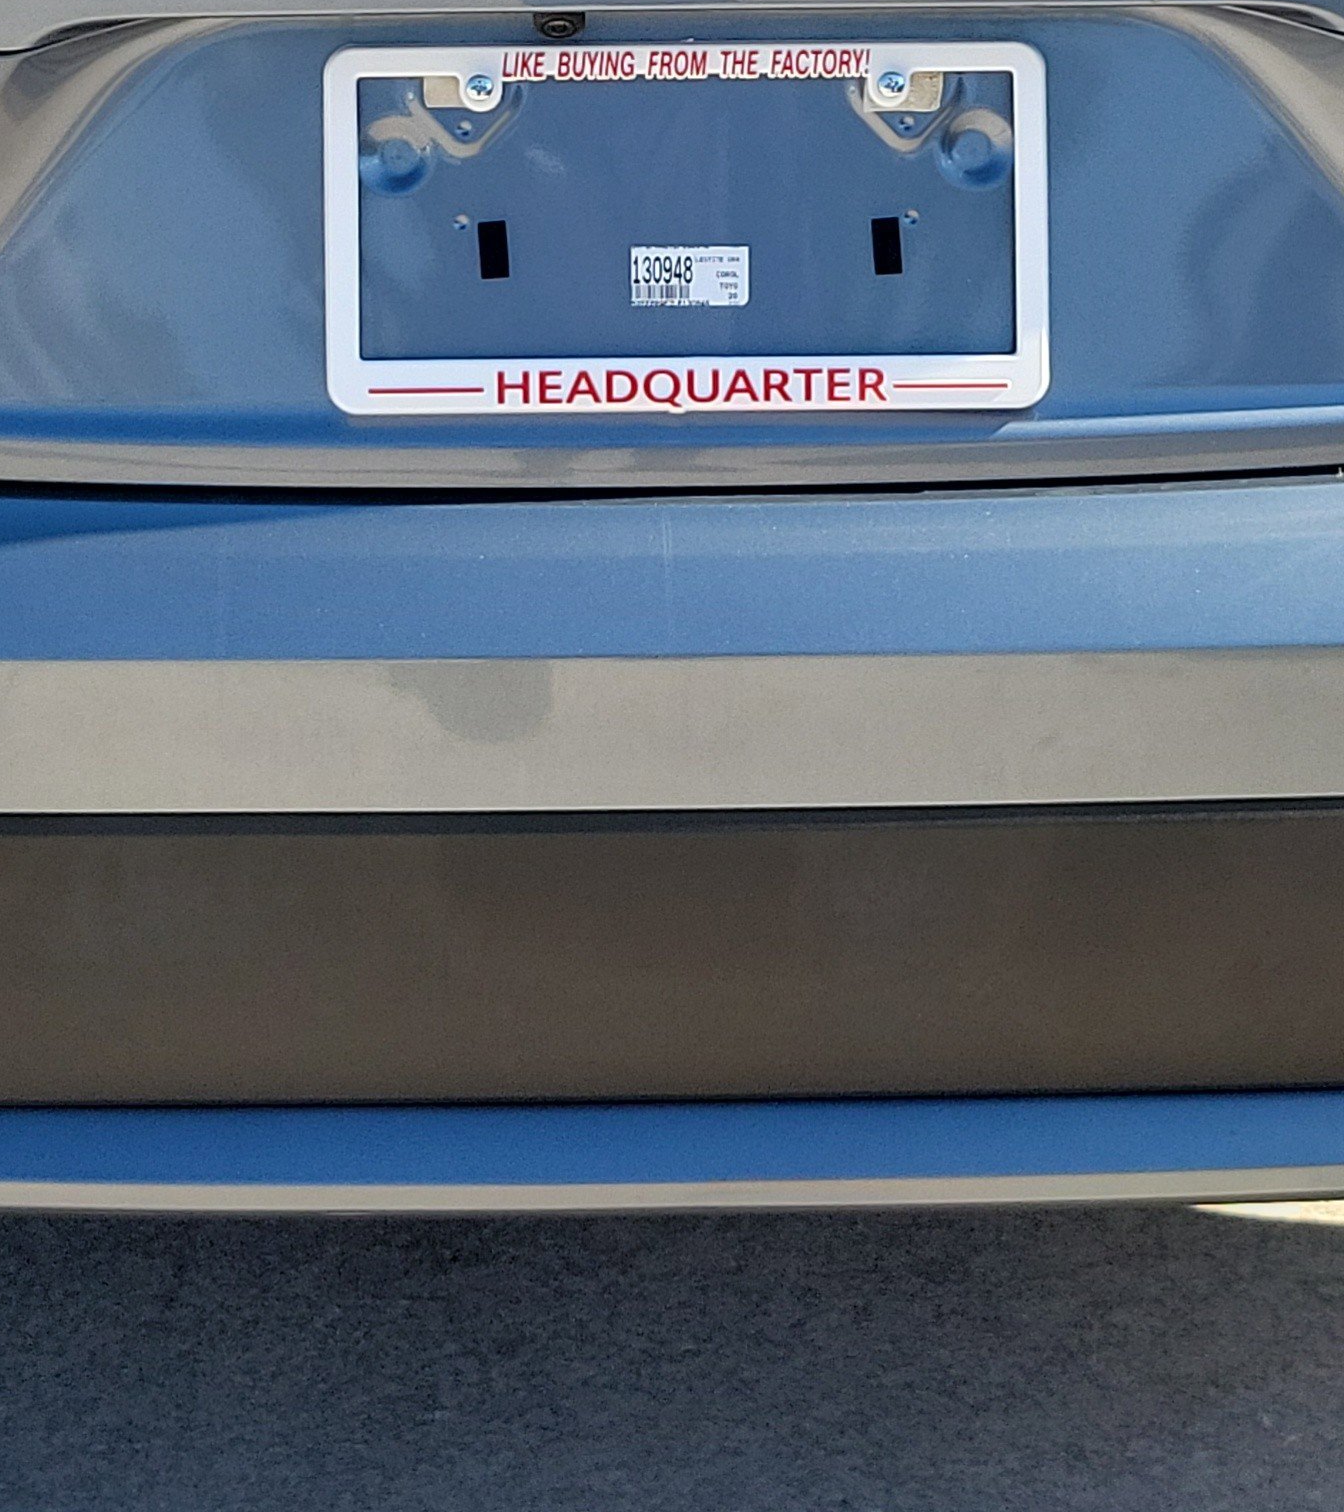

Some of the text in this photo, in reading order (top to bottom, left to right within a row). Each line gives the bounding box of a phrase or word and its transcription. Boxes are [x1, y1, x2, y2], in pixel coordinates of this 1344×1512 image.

[502, 48, 871, 78] LIKE BUYING FROM THE FACTORY!
[633, 255, 694, 285] 130948
[495, 368, 888, 408] HEADQUARTER
